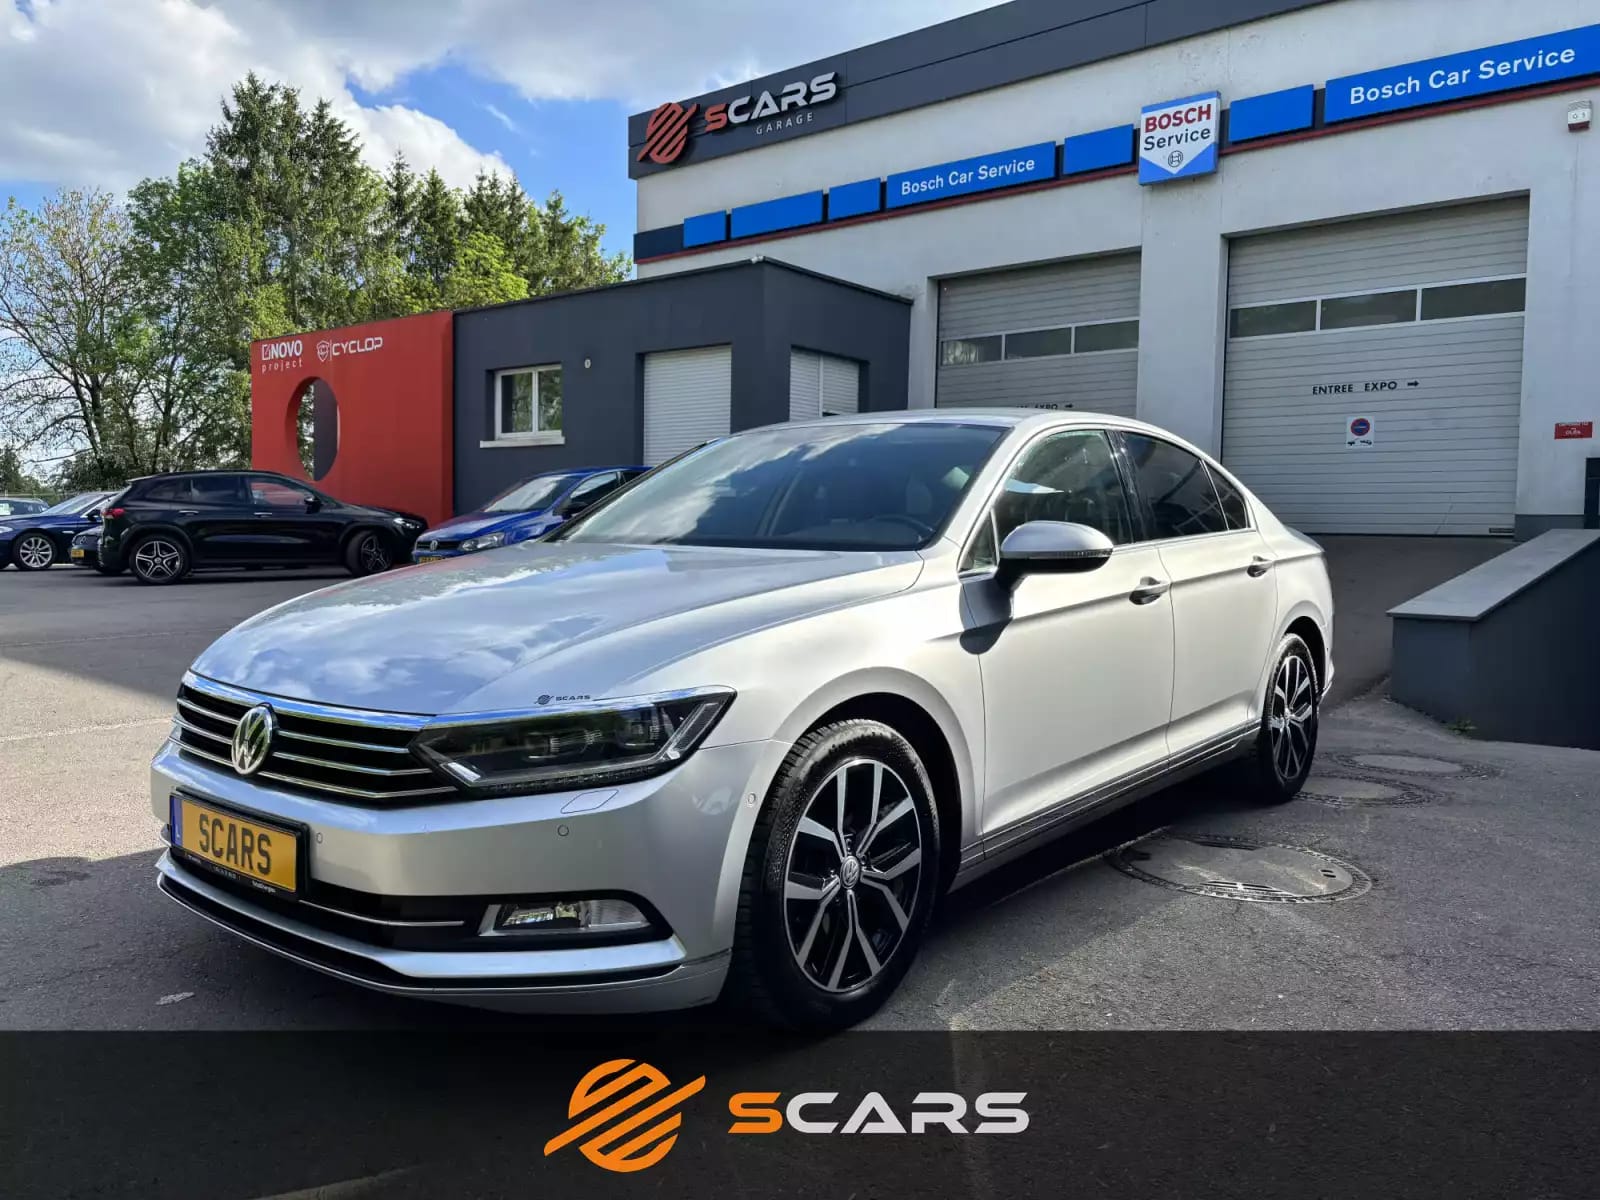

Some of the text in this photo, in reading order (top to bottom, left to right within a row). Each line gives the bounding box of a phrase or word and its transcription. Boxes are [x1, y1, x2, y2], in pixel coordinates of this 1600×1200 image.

[1350, 48, 1577, 105] Bosch Car Service
[704, 71, 838, 133] SCARS
[755, 112, 814, 135] GARAGE
[1144, 103, 1212, 133] BOSCH
[1143, 127, 1212, 151] Service
[901, 159, 1036, 196] Bosch Car Service
[332, 336, 384, 356] CYCLOP
[261, 358, 303, 374] project
[1312, 381, 1398, 396] ENTREE EXPO
[199, 812, 273, 876] SCARS
